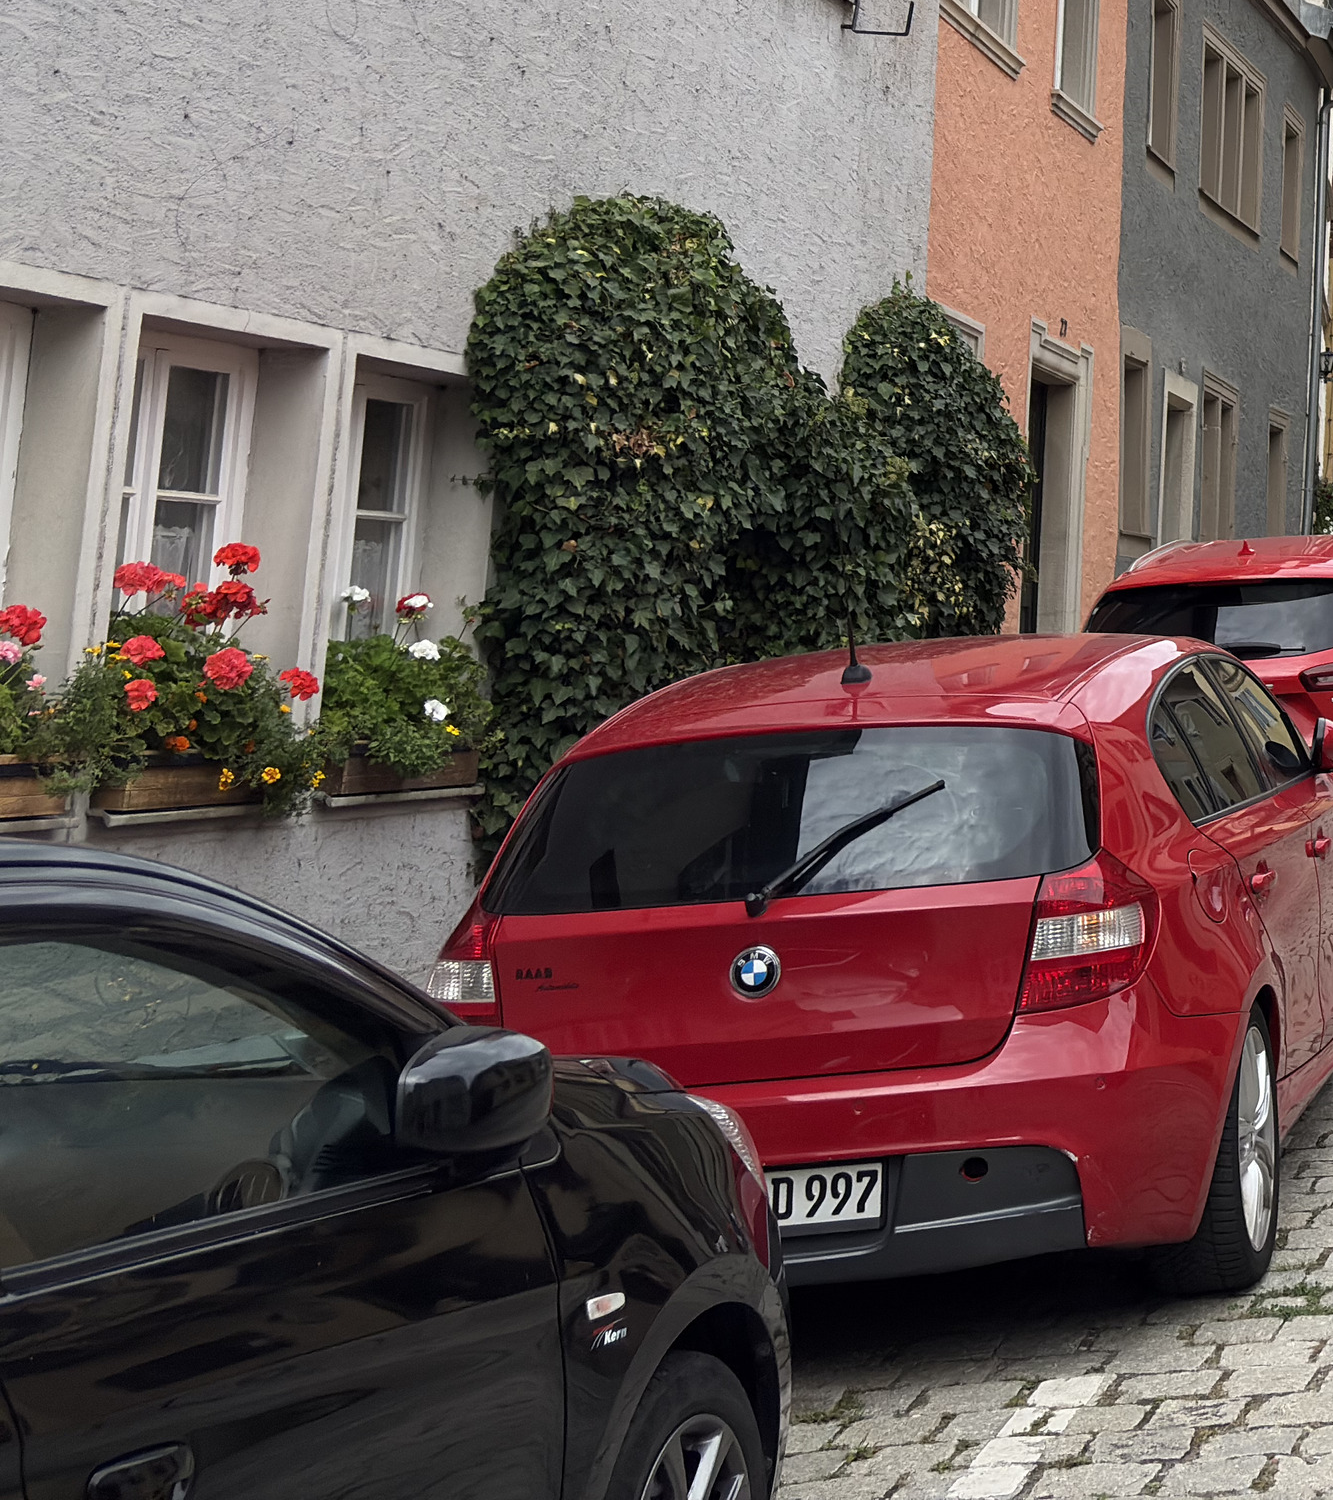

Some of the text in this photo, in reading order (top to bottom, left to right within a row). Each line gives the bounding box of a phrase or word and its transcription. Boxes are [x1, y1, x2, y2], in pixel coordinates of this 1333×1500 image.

[737, 952, 773, 968] BMW
[805, 1169, 878, 1218] 997
[603, 1327, 628, 1346] Kern
